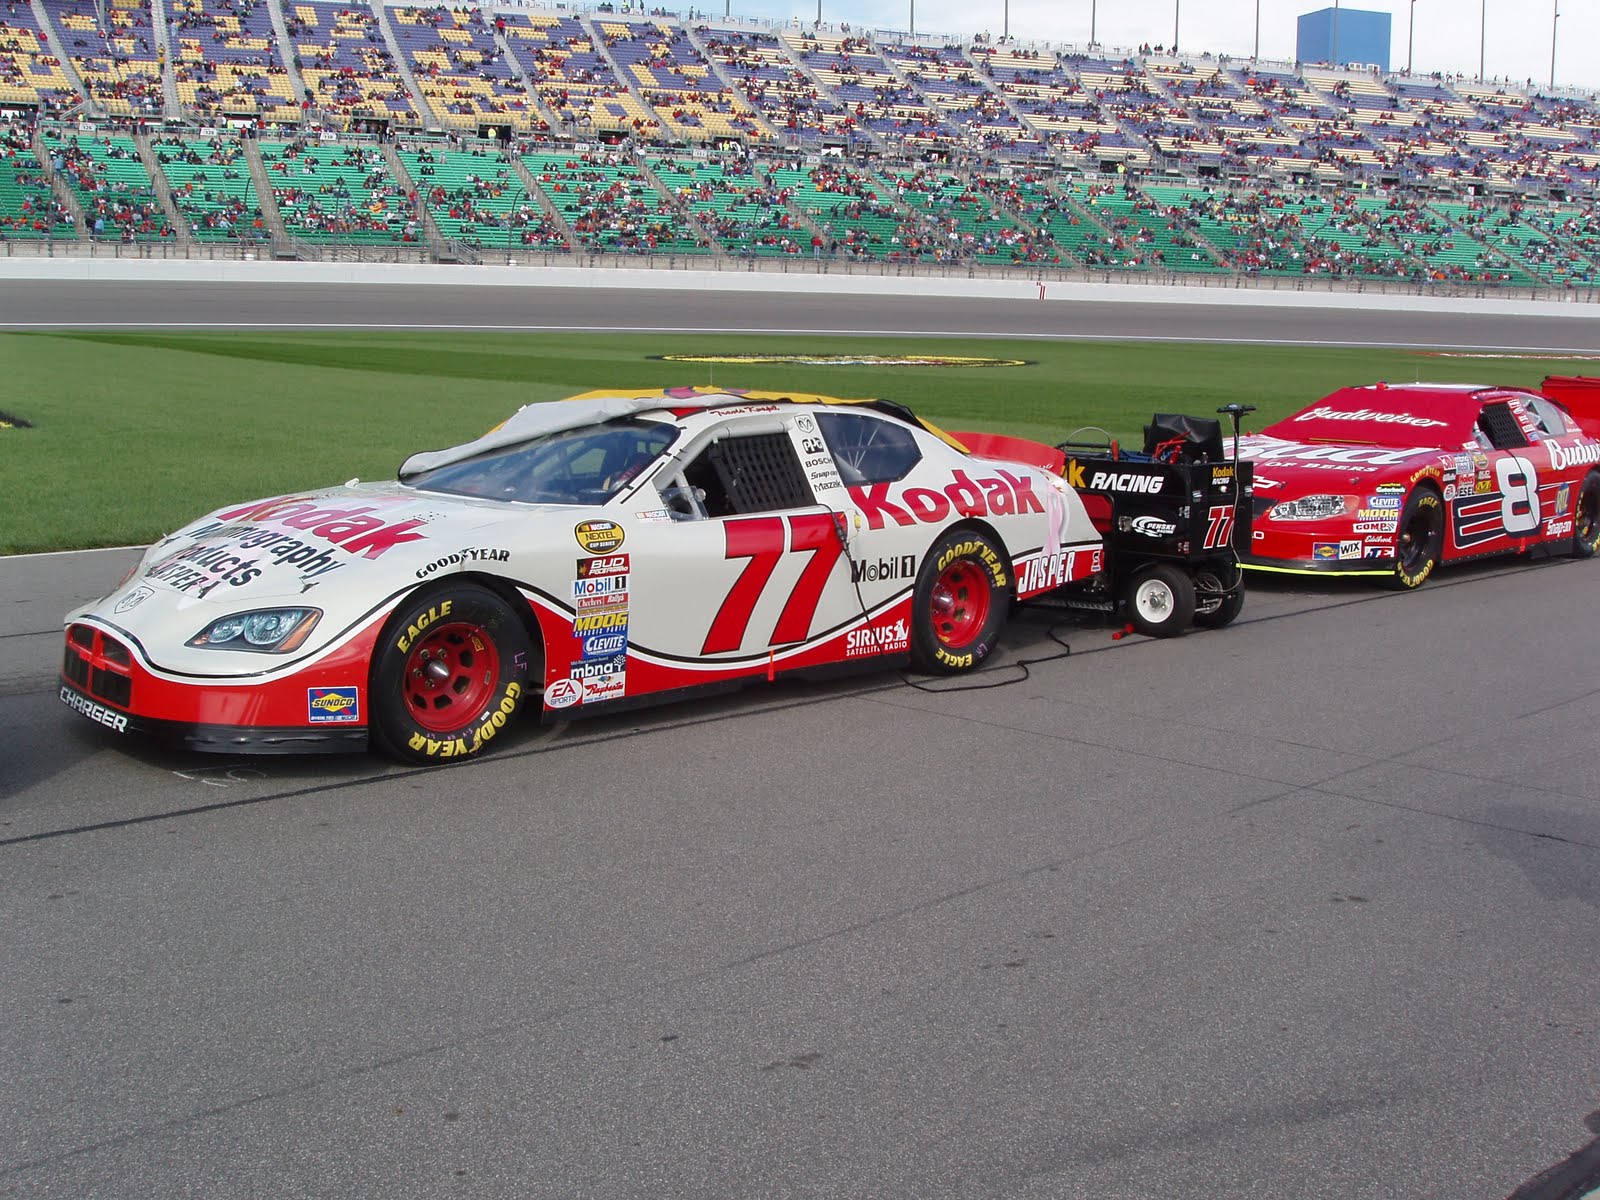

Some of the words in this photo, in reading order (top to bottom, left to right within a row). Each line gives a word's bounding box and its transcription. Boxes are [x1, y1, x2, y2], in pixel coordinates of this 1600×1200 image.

[1294, 405, 1448, 429] Budweiser
[802, 437, 824, 453] PPG
[805, 458, 833, 468] BOSCH
[1265, 460, 1299, 468] OF
[1300, 463, 1379, 473] BEERS
[1213, 466, 1234, 478] Kodak
[813, 479, 843, 492] Mazak
[1090, 472, 1165, 495] RACING
[1212, 477, 1230, 486] RACING
[845, 469, 1046, 532] Kodak
[1370, 496, 1399, 507] CLEVITE
[1495, 457, 1541, 533] 8
[645, 510, 667, 519] NASCAR
[1358, 509, 1399, 518] MOOG
[217, 496, 429, 561] Kodak
[589, 522, 613, 531] NASCAR
[1146, 522, 1177, 531] PENSKE
[1202, 505, 1234, 550] 77
[1356, 523, 1389, 531] COMP
[585, 531, 616, 541] NEXTEL
[1340, 542, 1360, 555] WIX
[415, 547, 510, 579] GOODYEAR
[591, 557, 625, 569] BUD
[851, 557, 898, 584] Mobil
[901, 555, 916, 579] 1
[936, 541, 1008, 588] GOODYEAR
[1018, 551, 1076, 593] JASPER
[574, 577, 611, 595] Mobil
[615, 576, 627, 590] 1
[701, 515, 844, 656] 77
[578, 597, 603, 609] Checkers
[607, 594, 625, 604] Rally's
[396, 600, 454, 654] EAGLE
[574, 612, 629, 633] MOOG
[574, 628, 603, 638] CHASSIS
[606, 624, 627, 634] PARTS
[586, 636, 624, 652] CLEVITE
[884, 639, 908, 651] RADIO
[934, 647, 973, 668] EAGLE
[571, 662, 614, 680] mbna
[552, 680, 577, 698] EA
[313, 697, 356, 712] SUNOCO
[550, 695, 577, 706] SPORTS
[59, 686, 129, 734] CHARGER
[408, 682, 522, 758] GOODYEAR
